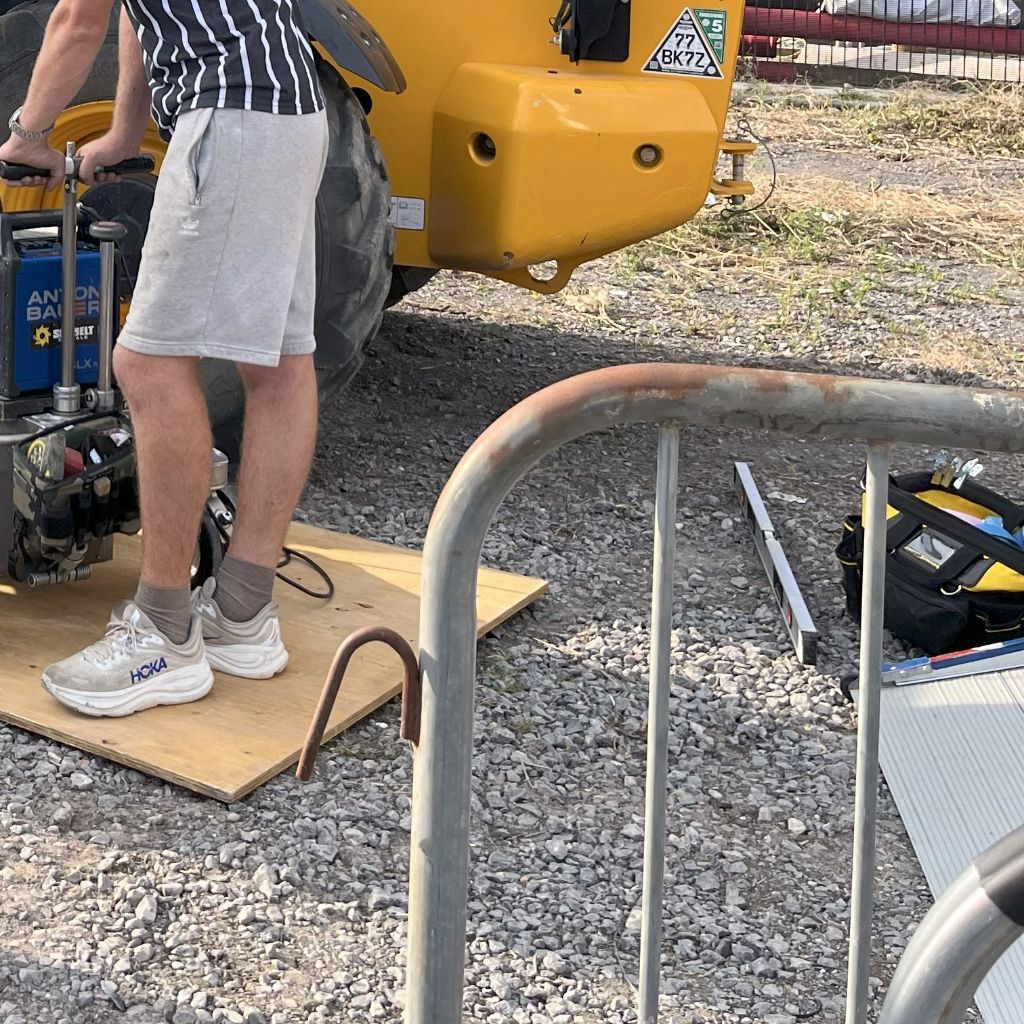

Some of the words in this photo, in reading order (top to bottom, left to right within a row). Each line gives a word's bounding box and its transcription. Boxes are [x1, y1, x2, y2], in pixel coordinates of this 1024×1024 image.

[711, 19, 723, 33] 5
[675, 33, 696, 49] 77
[662, 49, 705, 68] BK7Z
[27, 286, 100, 306] ANON
[26, 300, 100, 321] BAER
[130, 656, 168, 684] HOKA
